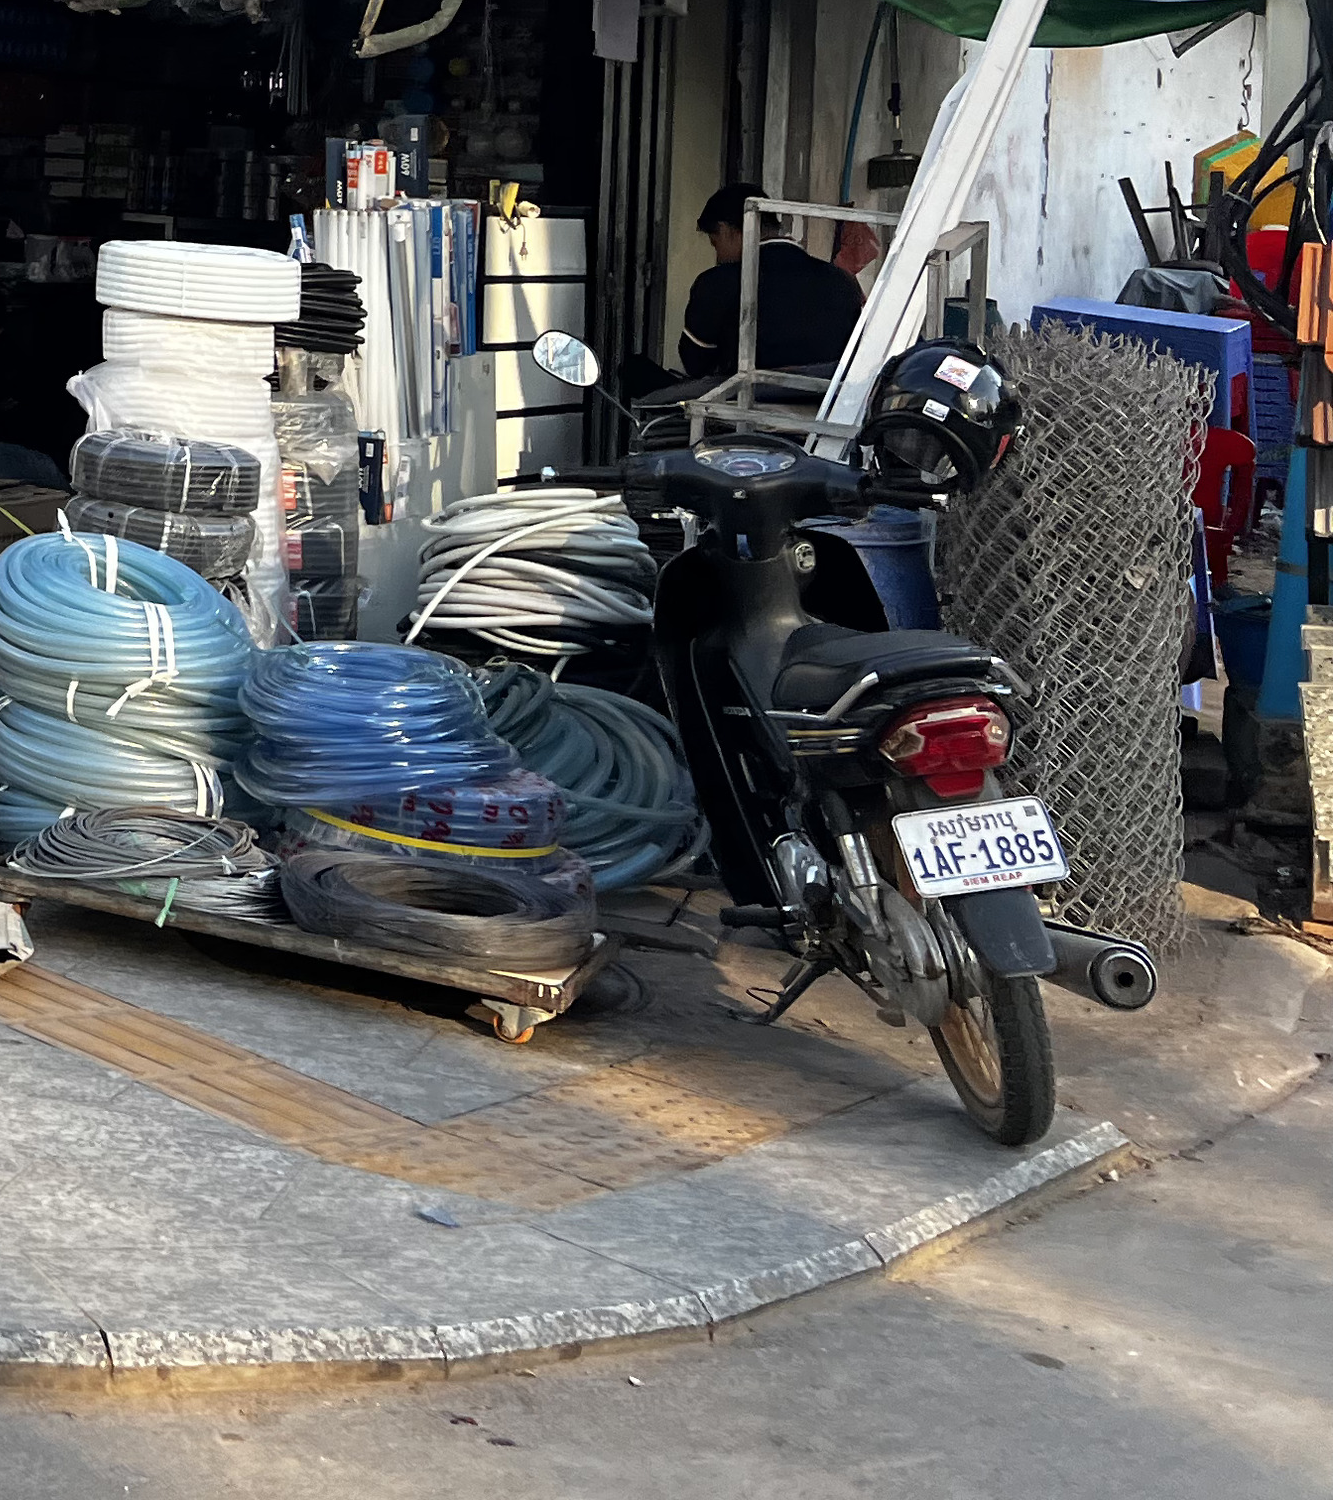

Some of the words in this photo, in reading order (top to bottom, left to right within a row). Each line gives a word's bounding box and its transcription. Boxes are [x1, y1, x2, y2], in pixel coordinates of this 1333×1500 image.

[913, 829, 1055, 879] 1AF-1885
[962, 875, 990, 887] SIEM
[993, 871, 1023, 884] REAP
